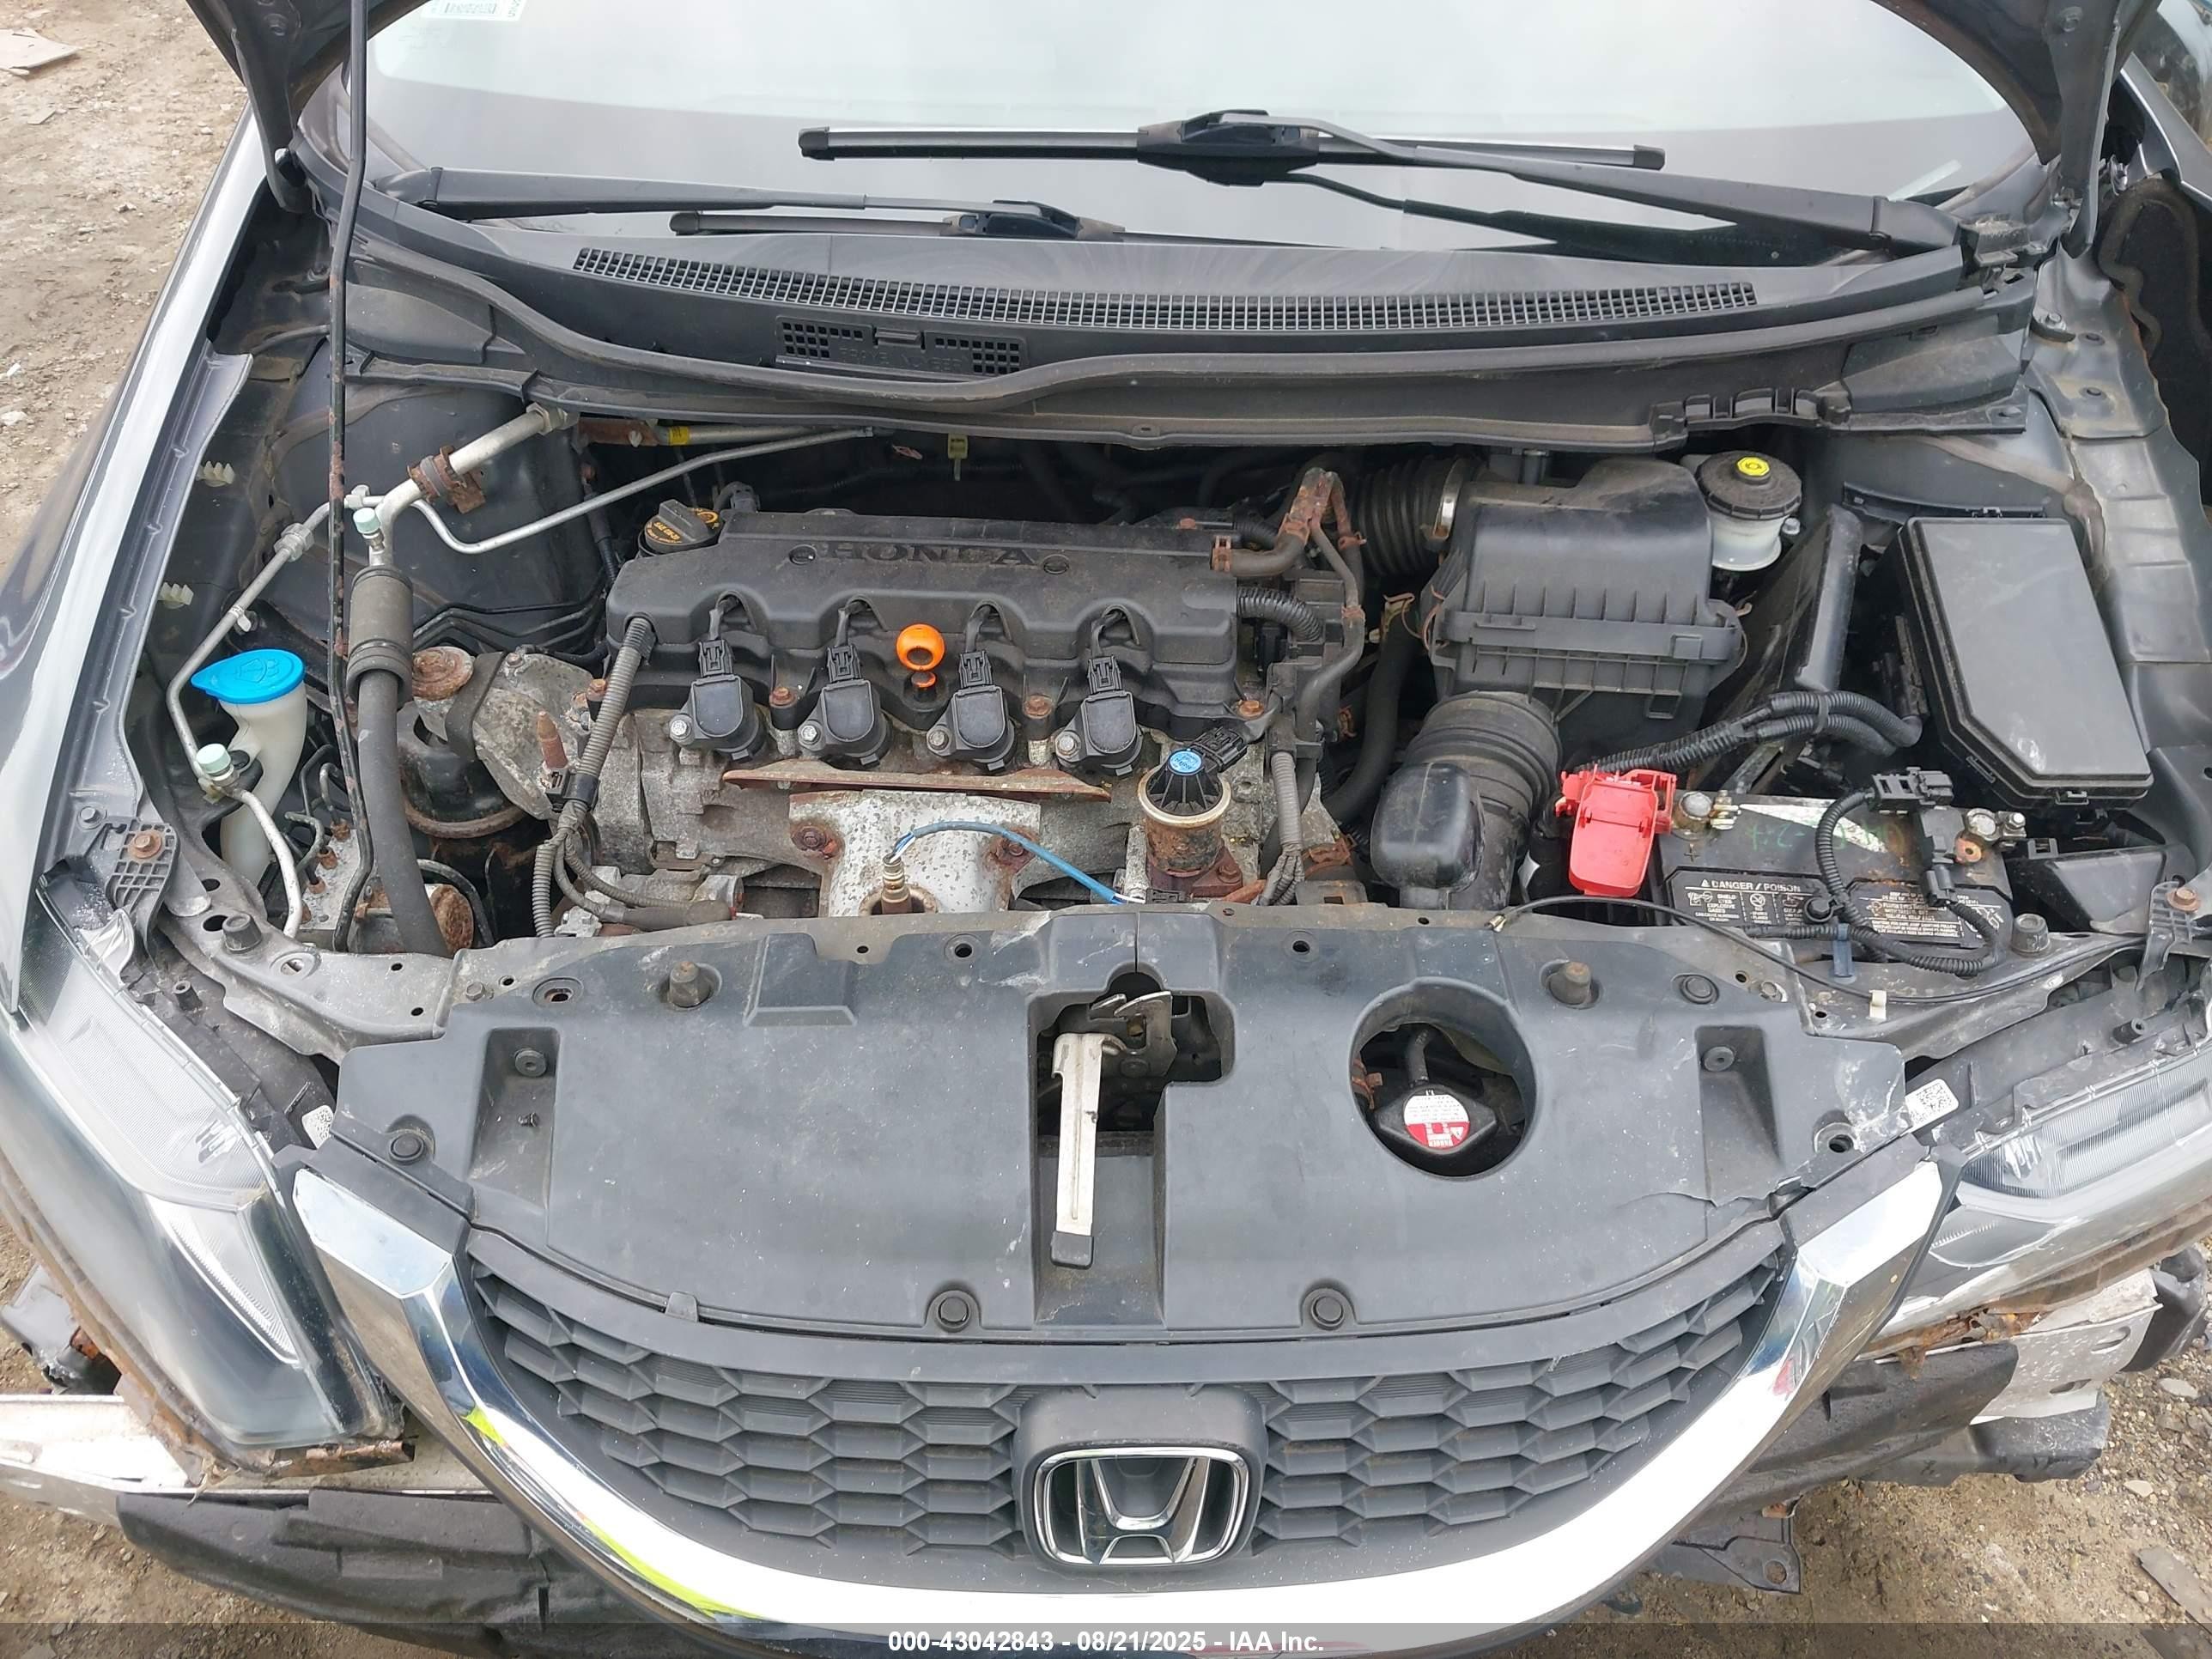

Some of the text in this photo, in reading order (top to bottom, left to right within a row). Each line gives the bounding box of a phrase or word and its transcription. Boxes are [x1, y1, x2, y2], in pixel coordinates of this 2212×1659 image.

[818, 543, 1038, 567] HONDA
[1711, 880, 1753, 890] DANGER
[1764, 883, 1801, 892] POISON
